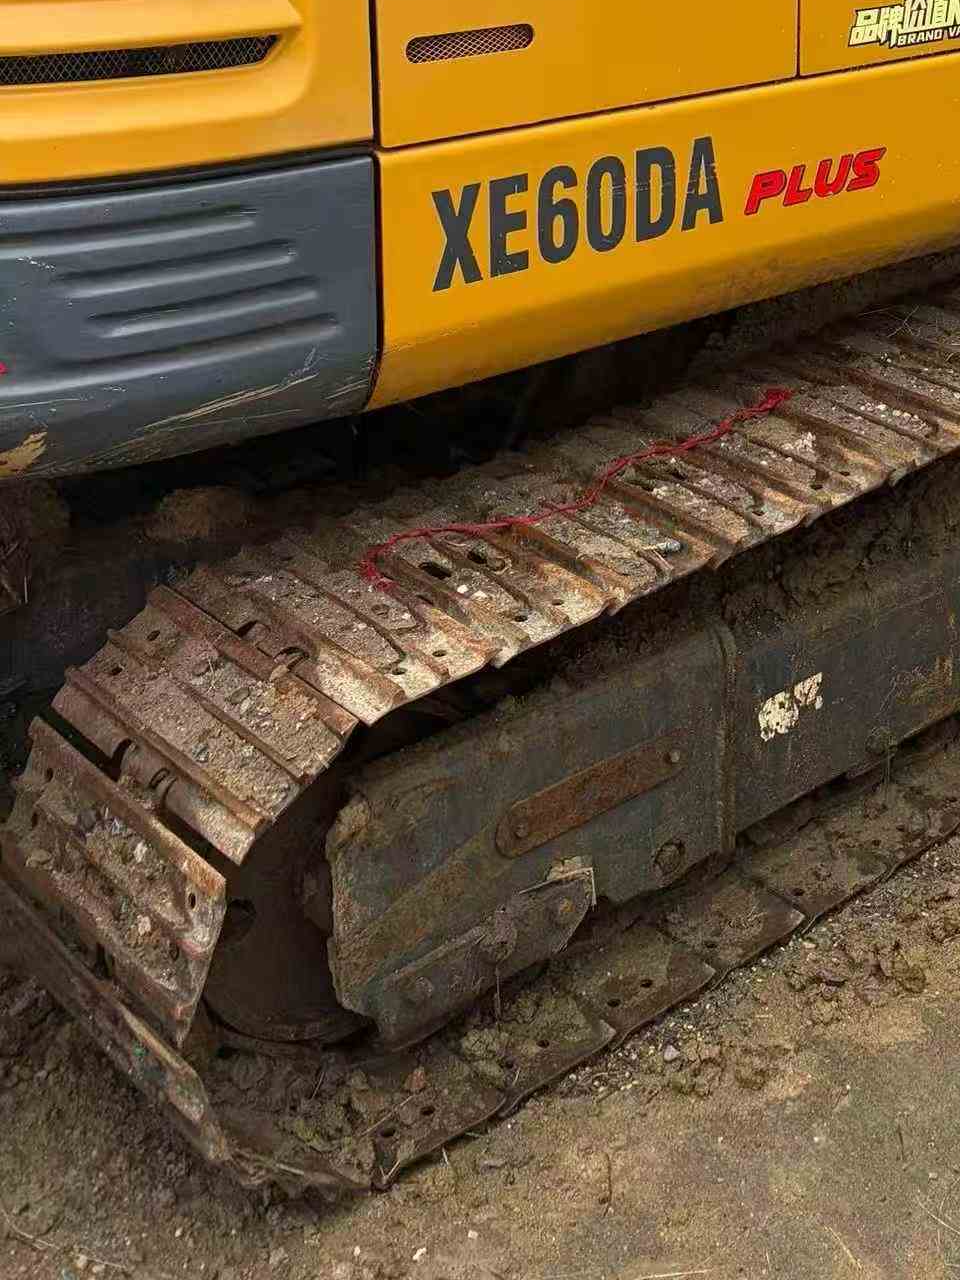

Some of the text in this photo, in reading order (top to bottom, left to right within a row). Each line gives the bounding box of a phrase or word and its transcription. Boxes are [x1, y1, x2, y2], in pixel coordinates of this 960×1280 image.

[897, 28, 943, 46] BRAND
[431, 135, 887, 292] XE60DA PLUS
